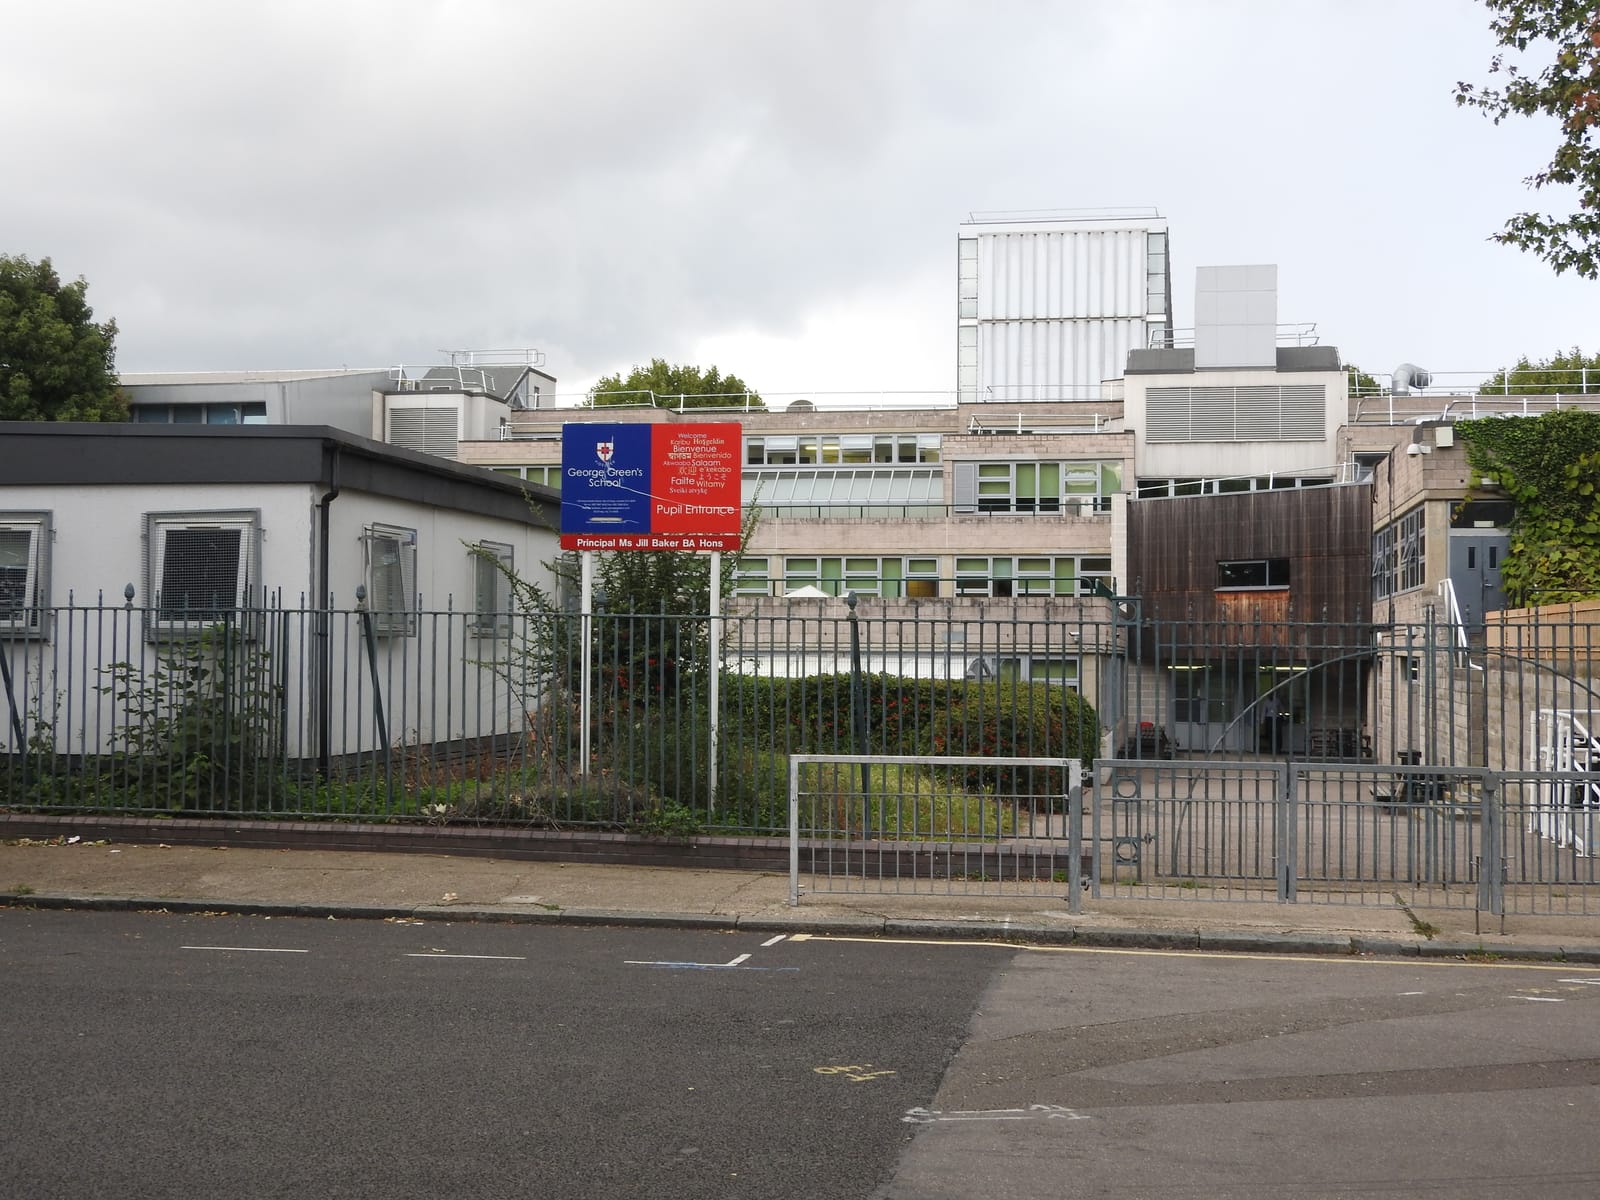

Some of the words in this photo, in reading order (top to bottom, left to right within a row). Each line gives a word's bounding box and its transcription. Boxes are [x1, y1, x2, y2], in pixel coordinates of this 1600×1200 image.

[673, 445, 717, 453] Bienvenue
[691, 459, 721, 467] Salaam
[567, 467, 605, 479] George
[607, 467, 643, 477] Green's
[589, 478, 621, 487] School
[696, 480, 725, 489] Witamy
[656, 504, 682, 516] Pupil
[685, 504, 735, 515] Entrance
[577, 538, 616, 549] Principal
[619, 539, 632, 548] Ms
[636, 538, 649, 548] Jill
[652, 538, 679, 548] Baker
[682, 538, 696, 548] BA
[699, 538, 724, 548] Hons
